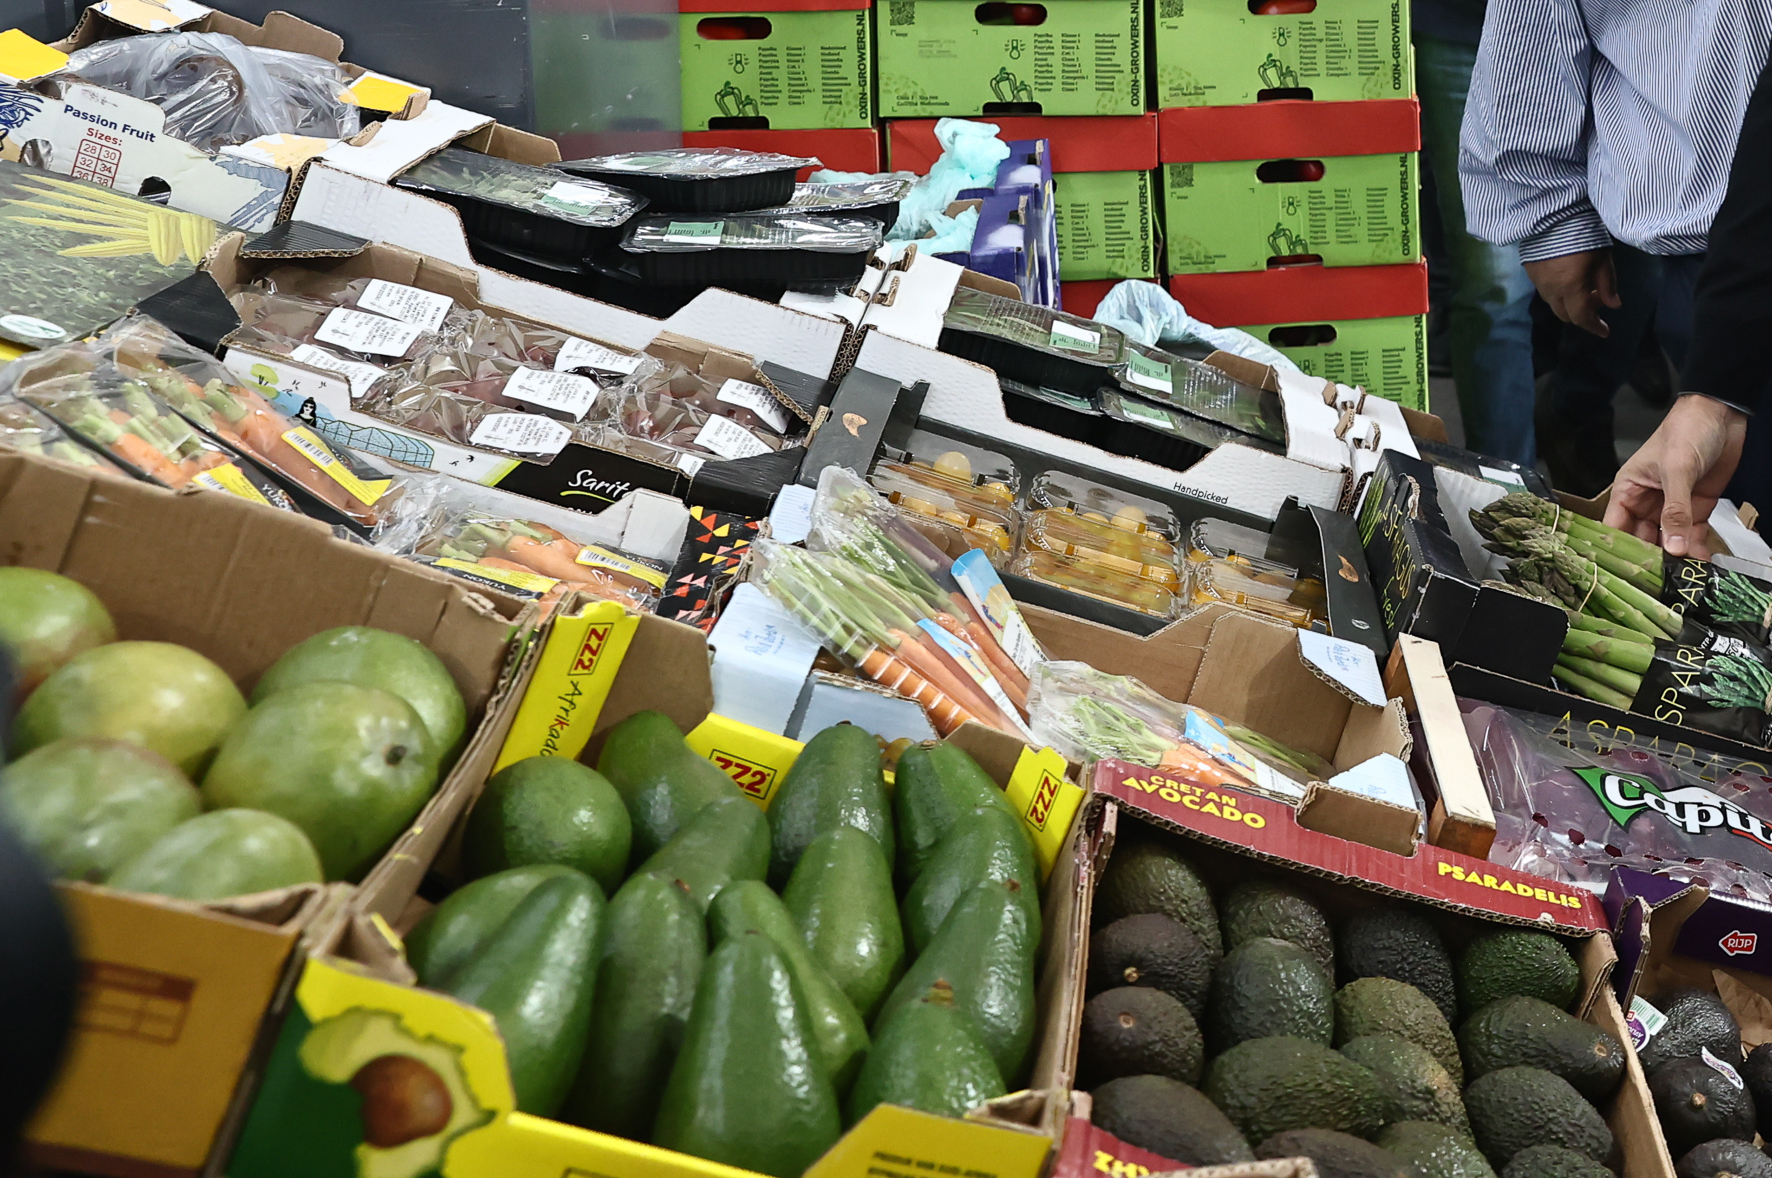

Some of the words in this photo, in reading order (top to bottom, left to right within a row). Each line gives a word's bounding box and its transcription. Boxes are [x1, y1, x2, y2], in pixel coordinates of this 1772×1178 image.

[856, 10, 868, 120] OXIN-GROWERS.NL
[63, 104, 118, 130] Passion
[121, 123, 156, 142] Fruit
[86, 127, 123, 146] Sizes:
[79, 157, 93, 169] 32
[99, 163, 113, 176] 34
[83, 143, 97, 155] 28
[103, 149, 117, 161] 30
[1173, 481, 1229, 505] Handpicked
[463, 572, 507, 591] YUKON
[573, 627, 609, 671] ZZ2
[1030, 775, 1057, 828] ZZ2
[1121, 776, 1266, 830] AVOCADO
[1151, 775, 1237, 807] CRETAN
[1437, 861, 1583, 910] PSARADELIS
[1726, 937, 1753, 950] RIJP
